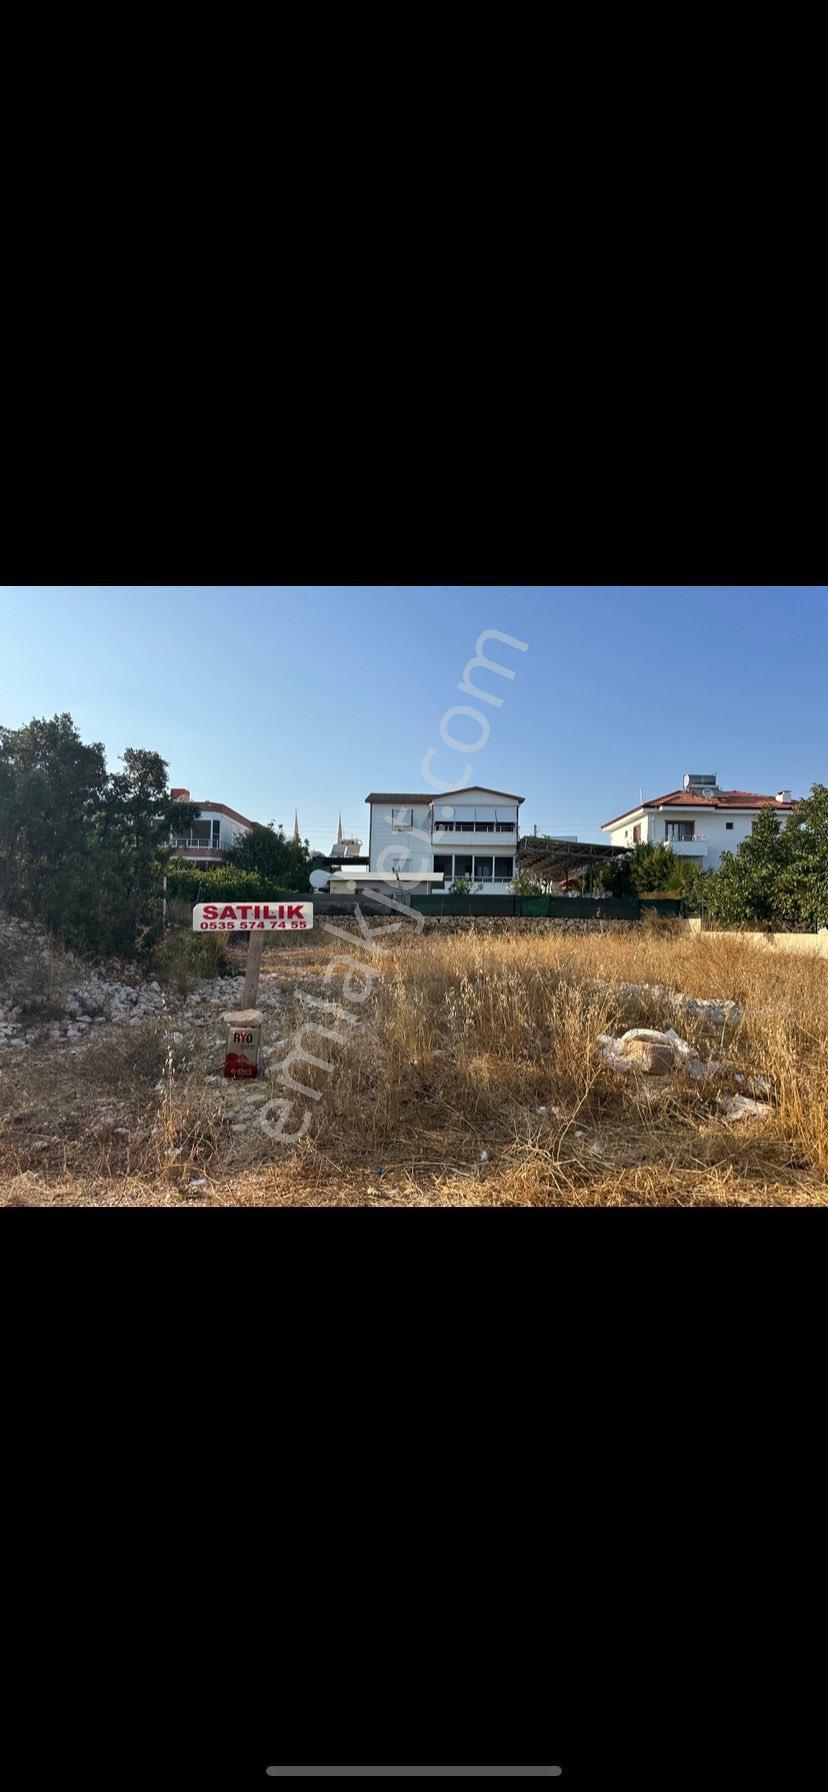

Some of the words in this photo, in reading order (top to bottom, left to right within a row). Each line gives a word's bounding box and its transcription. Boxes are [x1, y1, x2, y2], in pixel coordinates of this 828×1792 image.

[202, 905, 305, 920] SATILIK
[200, 921, 235, 930] 0535
[239, 921, 265, 929] 574
[269, 921, 287, 929] 74
[290, 920, 307, 929] 55
